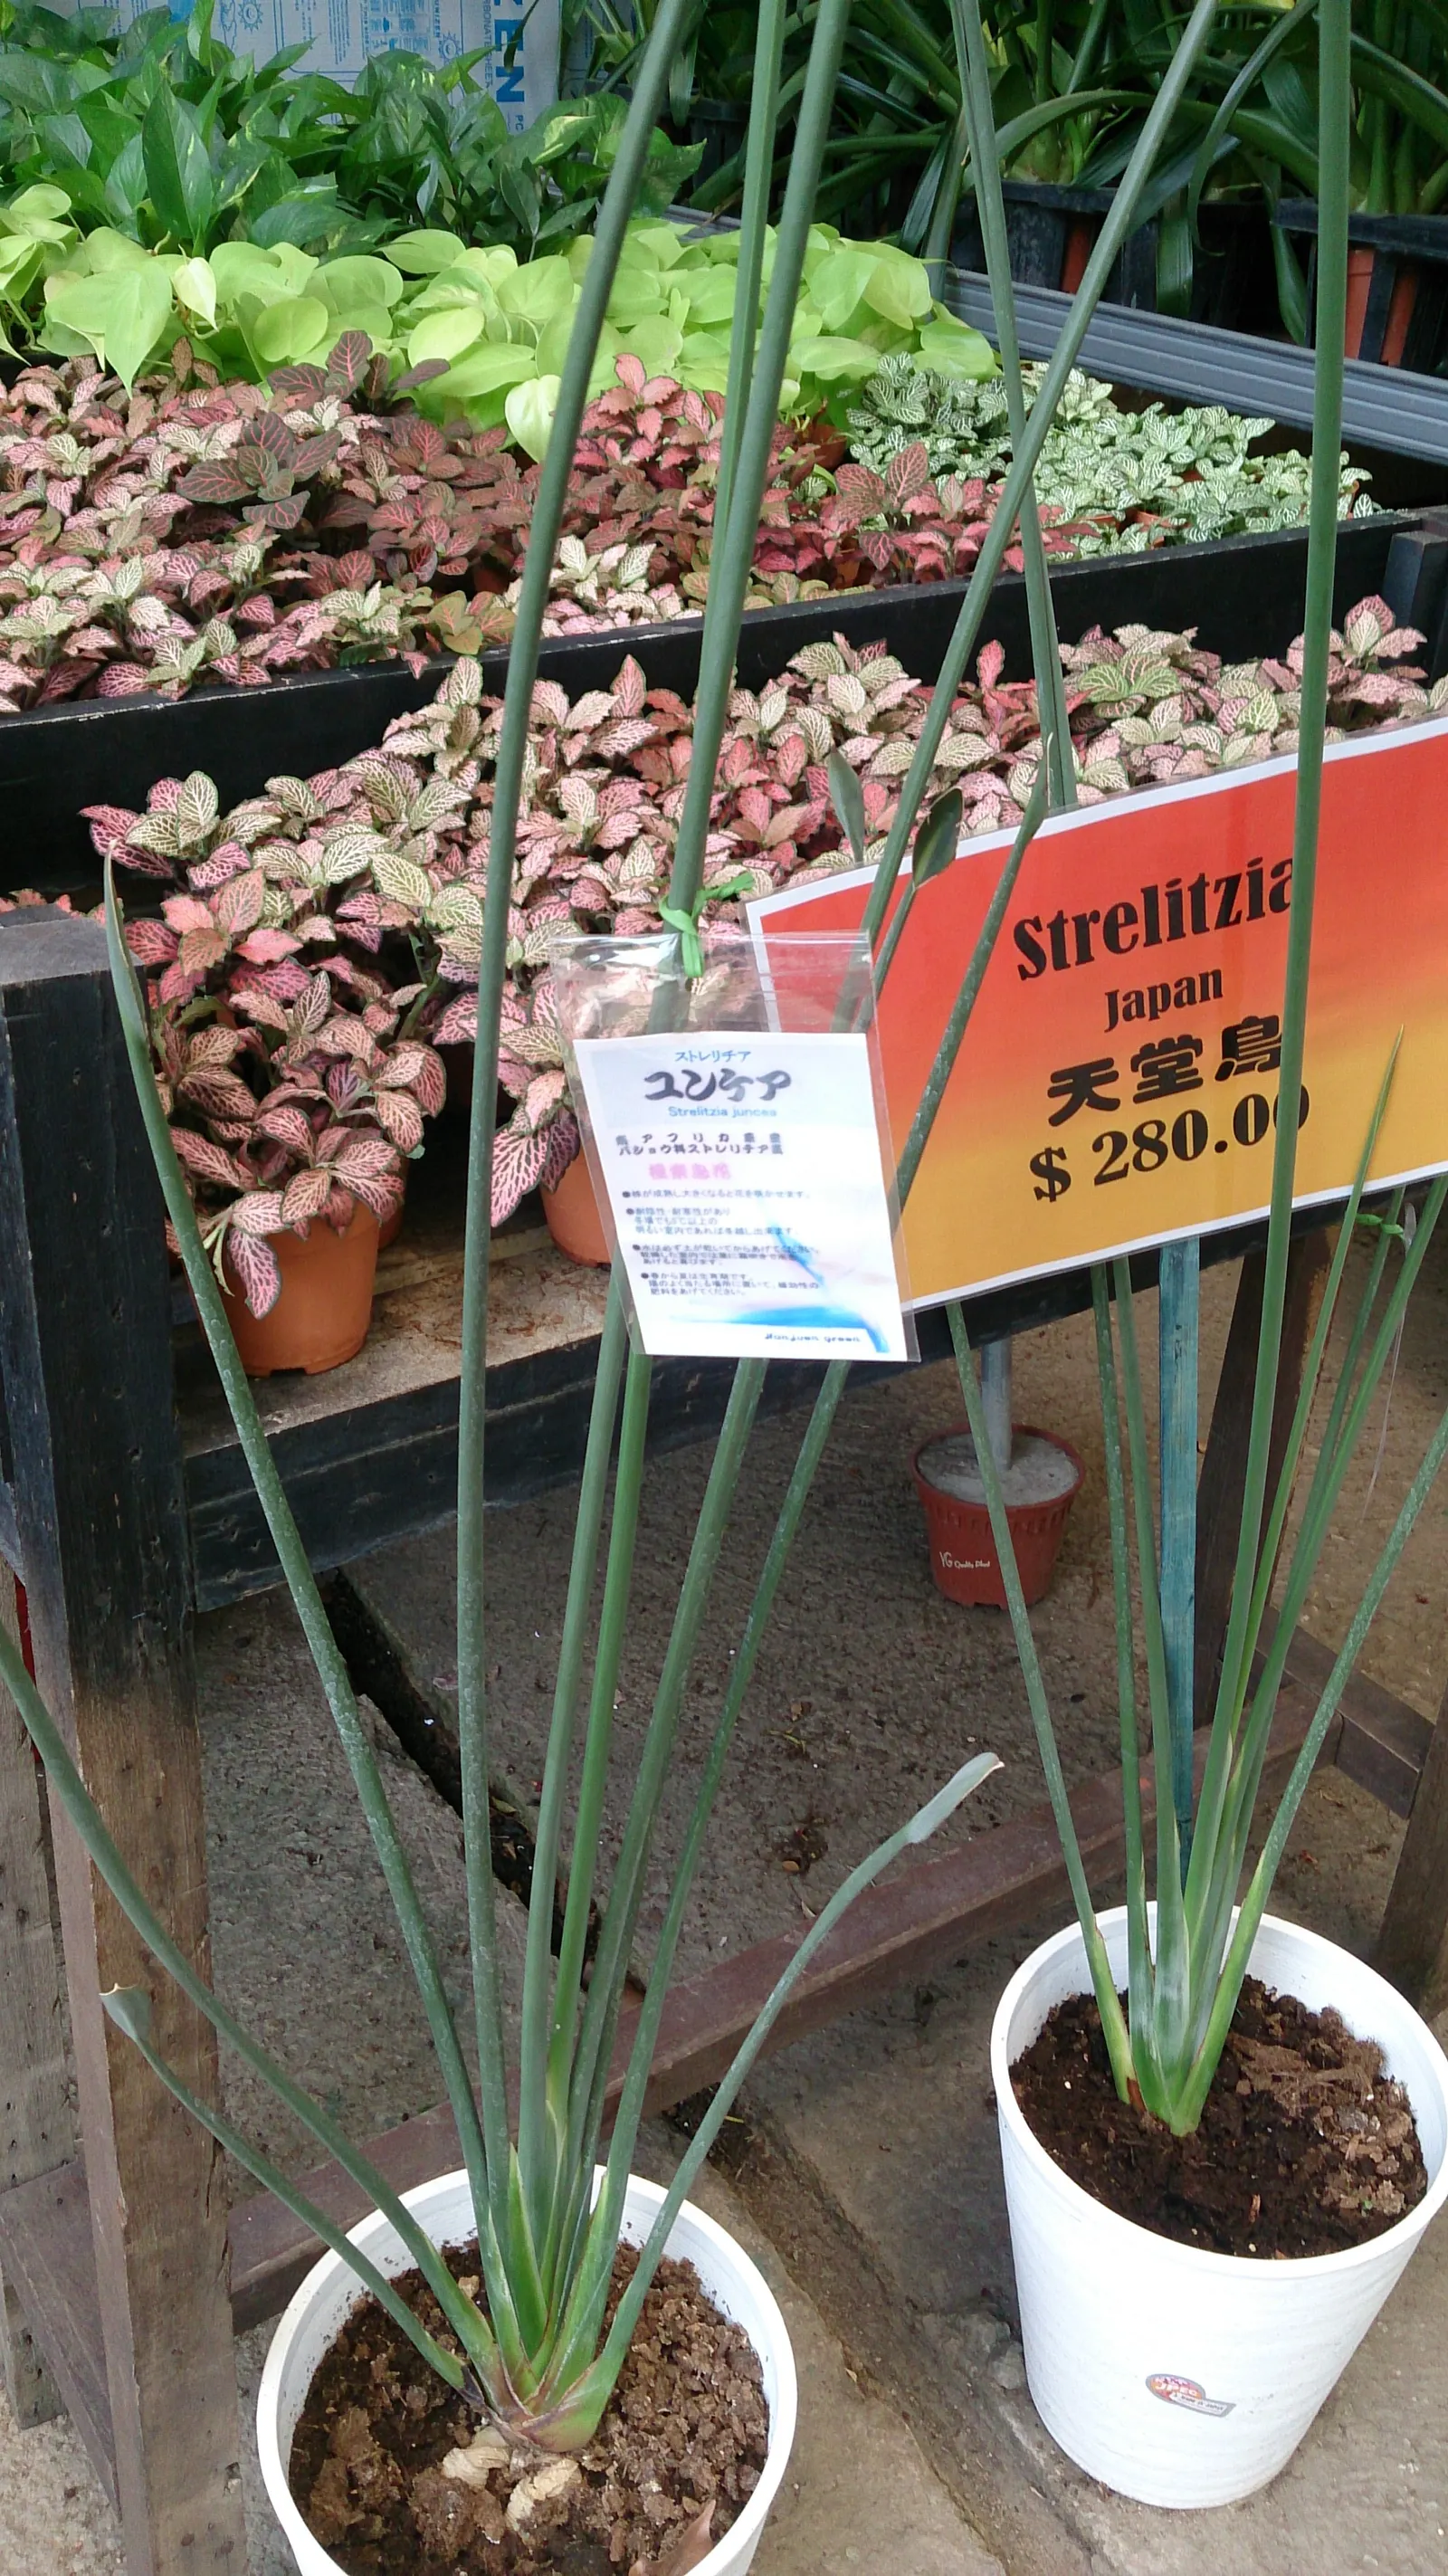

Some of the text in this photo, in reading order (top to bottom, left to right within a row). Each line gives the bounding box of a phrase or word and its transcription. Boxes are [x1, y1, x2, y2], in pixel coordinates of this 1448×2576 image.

[494, 0, 525, 103] EN
[1013, 855, 1294, 981] Strelitzia
[1104, 968, 1224, 1033] Japan
[643, 1067, 792, 1102] ユンケア
[674, 1049, 752, 1064] ストレリチア
[1047, 1014, 1283, 1128] 天堂鳥
[668, 1105, 778, 1119] Strelitzia juncea
[1029, 1145, 1072, 1203] $
